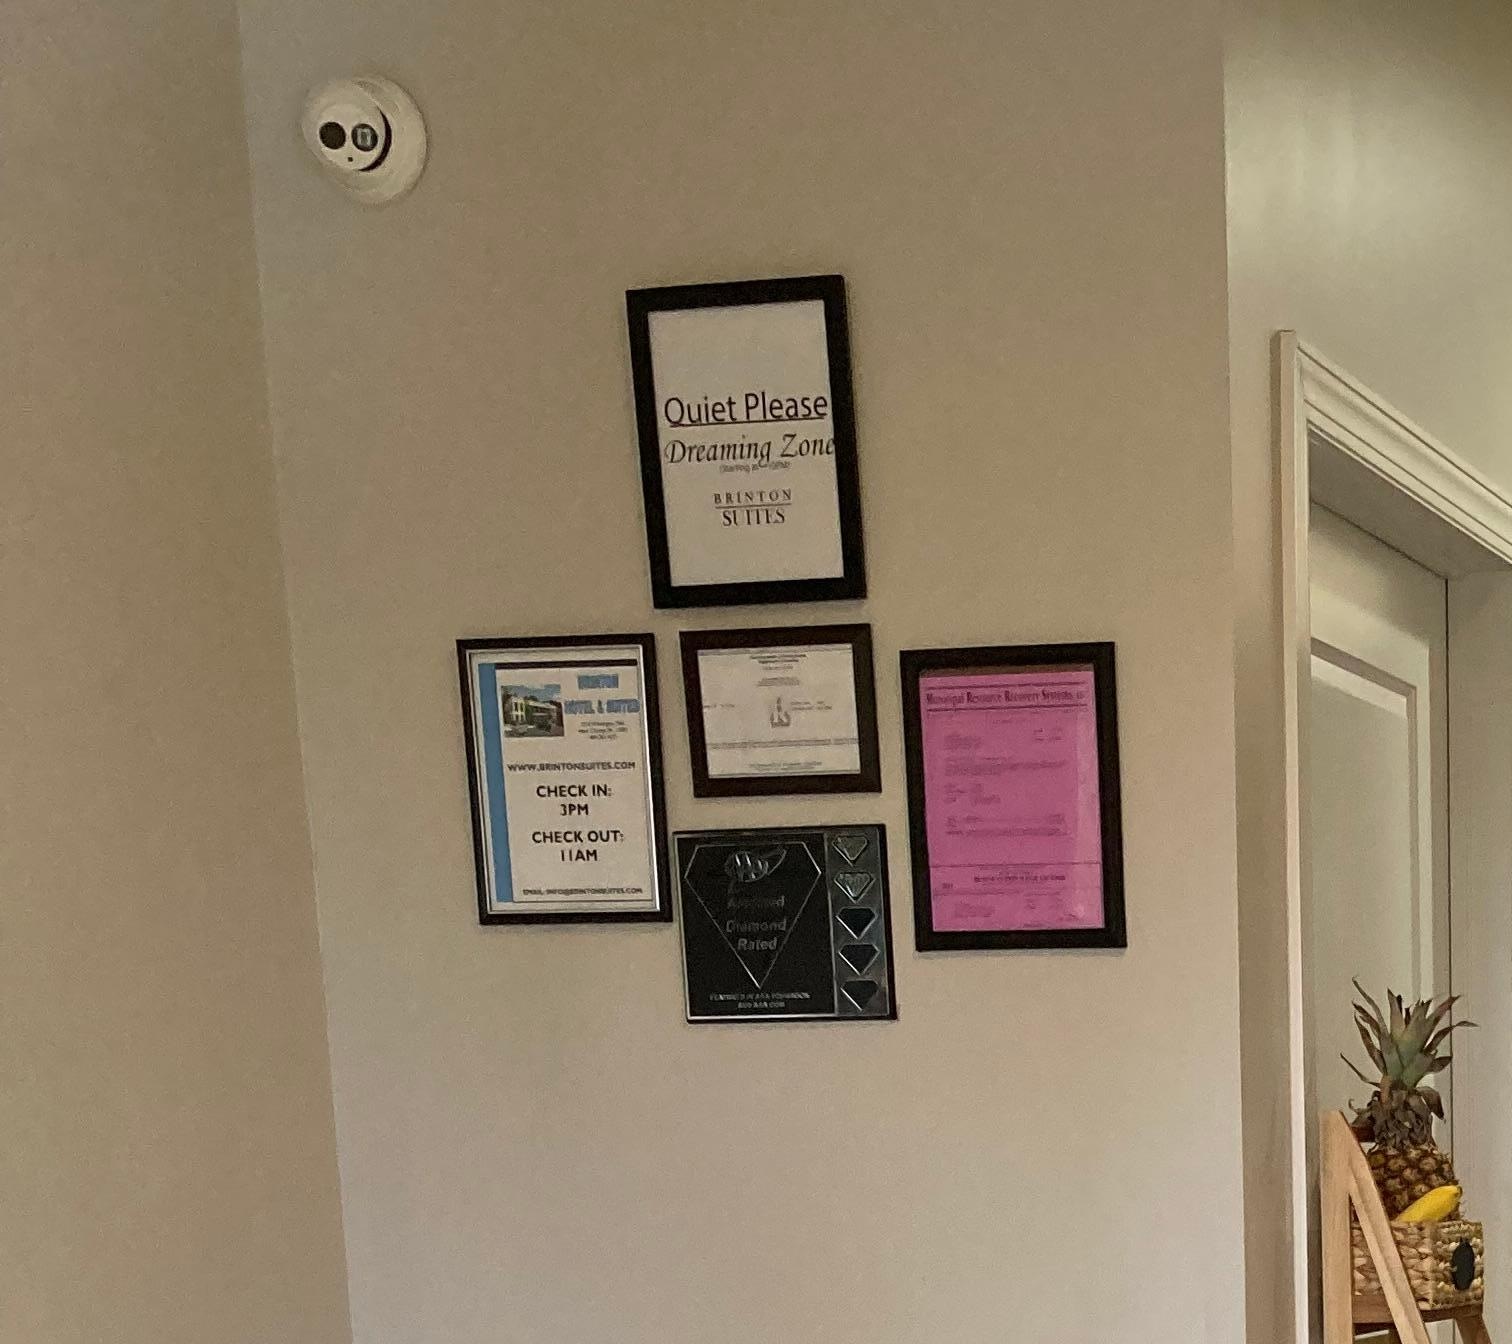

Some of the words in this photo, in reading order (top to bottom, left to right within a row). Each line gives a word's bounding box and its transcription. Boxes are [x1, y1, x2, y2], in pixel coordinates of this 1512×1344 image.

[664, 396, 737, 425] Quiet
[745, 391, 828, 419] Please
[664, 435, 772, 467] Dreaming
[780, 433, 835, 458] Zone
[713, 488, 792, 504] BRINTON
[722, 509, 785, 526] SUITES
[507, 761, 636, 772] WWW.BRINTONSUITES.COM
[536, 785, 588, 798] CHECK
[592, 784, 612, 797] IN:
[560, 803, 589, 816] 3PM
[532, 831, 584, 844] CHECK
[587, 830, 624, 843] OUT:
[560, 850, 598, 863] 11AM
